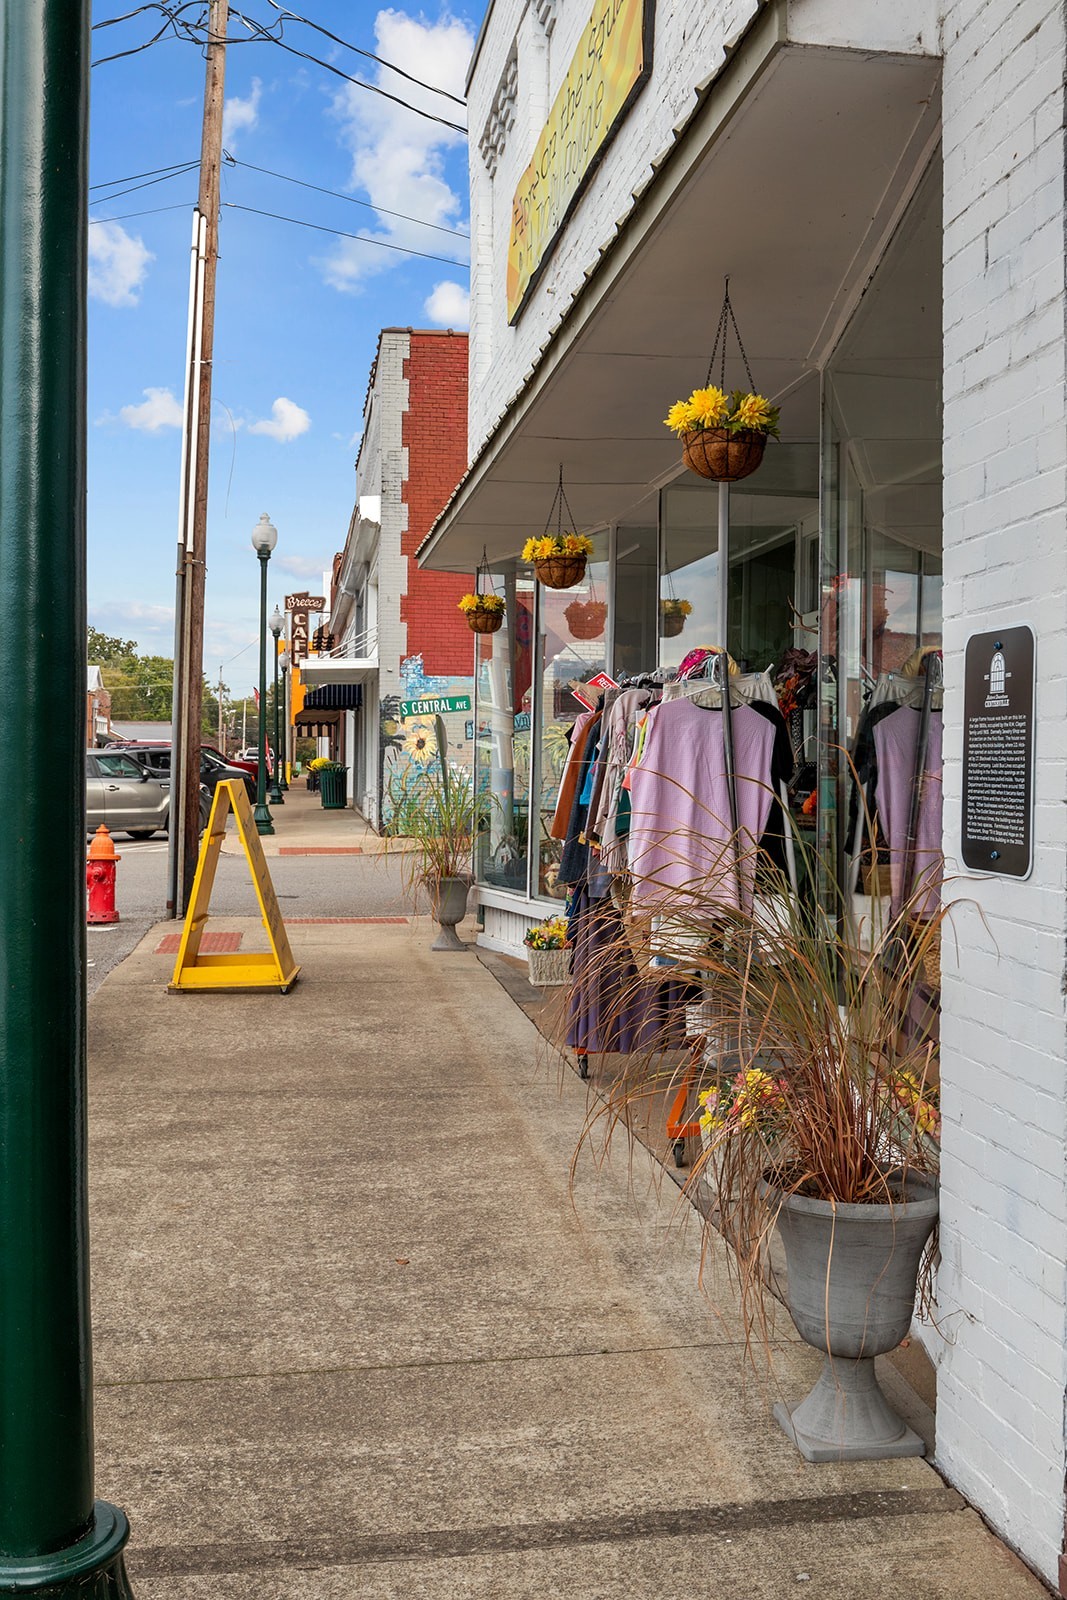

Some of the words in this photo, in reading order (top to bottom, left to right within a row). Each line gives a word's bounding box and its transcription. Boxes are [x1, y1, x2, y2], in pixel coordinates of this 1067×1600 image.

[560, 73, 583, 139] the
[401, 702, 408, 715] S
[411, 699, 452, 714] CENTRAL
[455, 700, 467, 710] AVE
